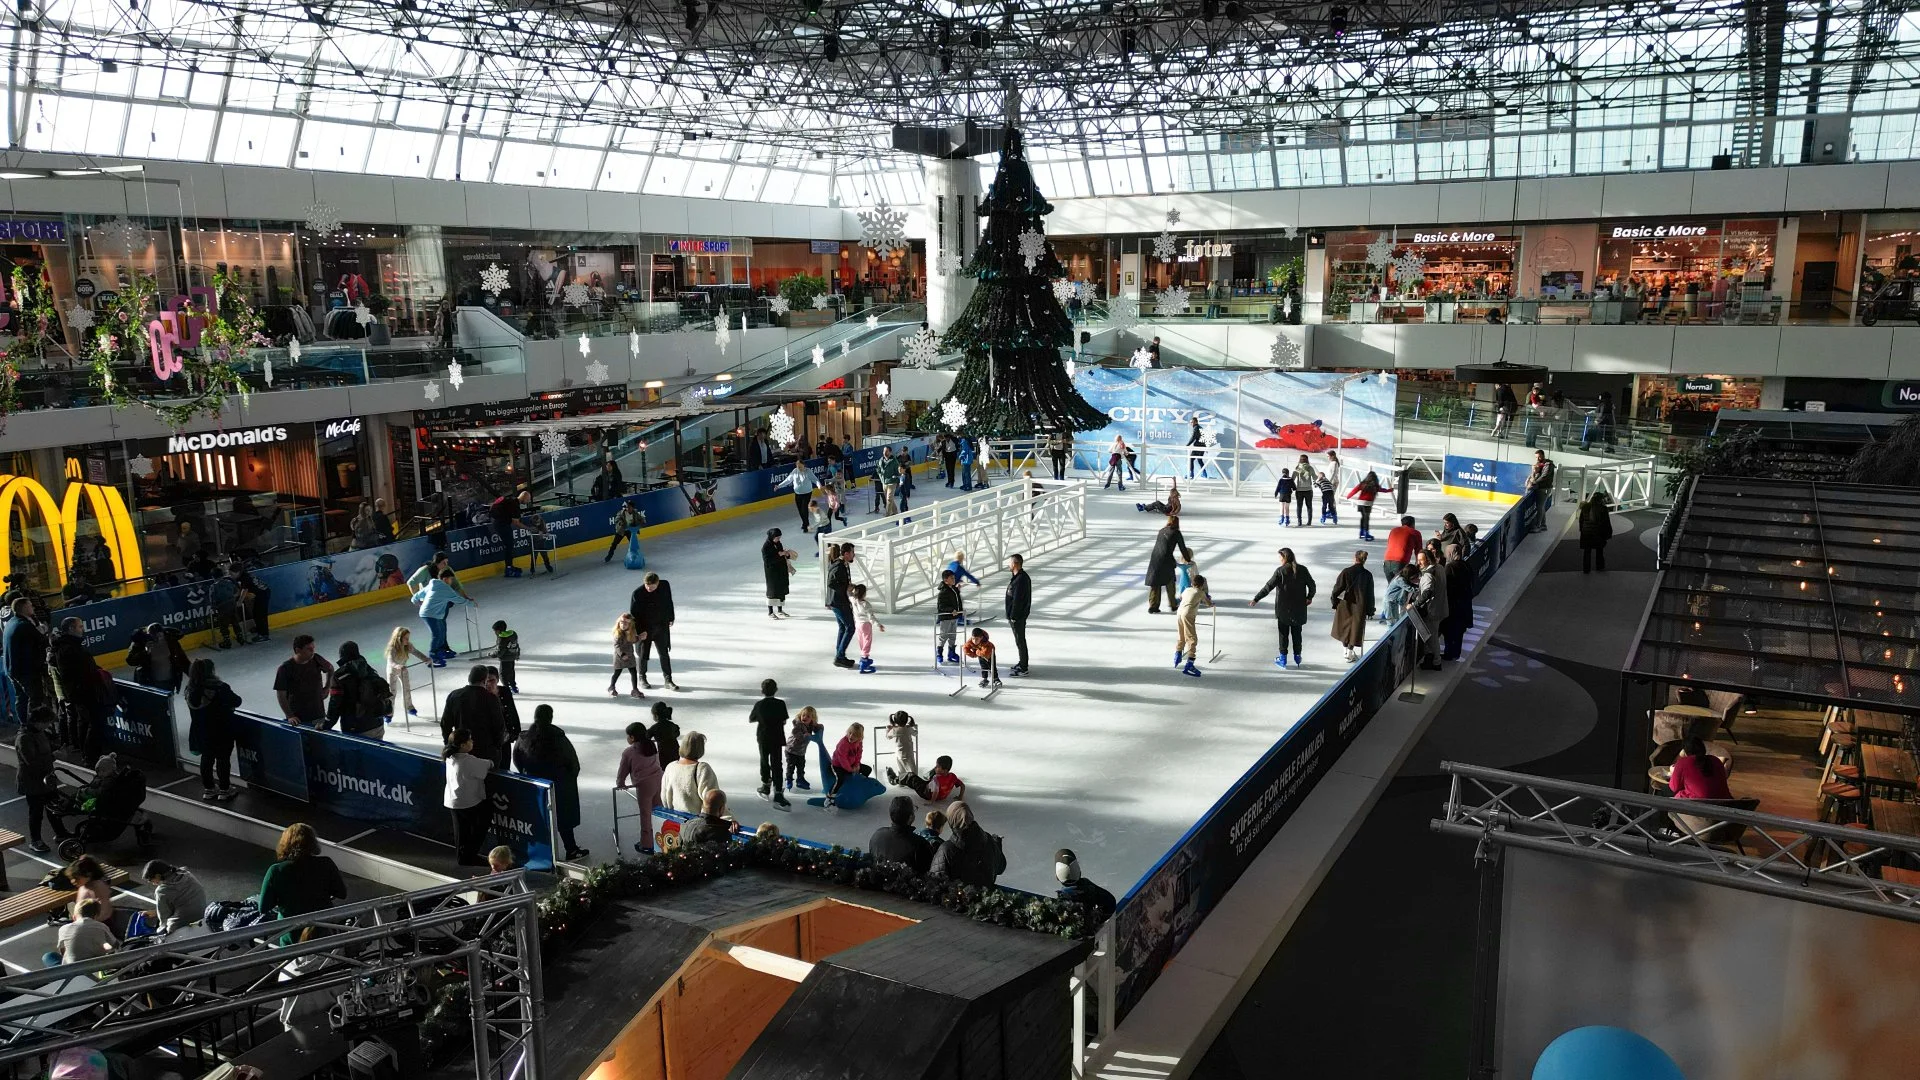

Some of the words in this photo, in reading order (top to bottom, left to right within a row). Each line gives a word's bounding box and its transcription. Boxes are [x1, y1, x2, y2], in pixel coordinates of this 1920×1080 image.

[1413, 232, 1448, 243] Basic
[1449, 232, 1461, 242] &
[1462, 232, 1496, 242] More
[1612, 225, 1652, 238] Basic
[1653, 226, 1667, 237] &
[1668, 225, 1707, 236] More
[678, 240, 729, 252] INTERSPORT
[1685, 382, 1713, 391] Normal
[497, 407, 518, 417] biggest
[519, 404, 542, 414] supplier
[549, 402, 568, 410] Europe
[325, 418, 361, 438] McCafé
[168, 426, 288, 453] McDonald's
[1458, 471, 1498, 484] HØJMARK
[450, 537, 490, 553] EKSTRA
[163, 605, 216, 625] HØJMA
[107, 716, 153, 738] ØJMARK
[309, 764, 414, 806] .hojmark.dk
[1230, 794, 1264, 845] SKIFERIE
[1264, 778, 1279, 808] FOR
[1279, 759, 1296, 791] HELE
[1296, 729, 1325, 773] FAMILIEN
[491, 812, 534, 836] JMARK
